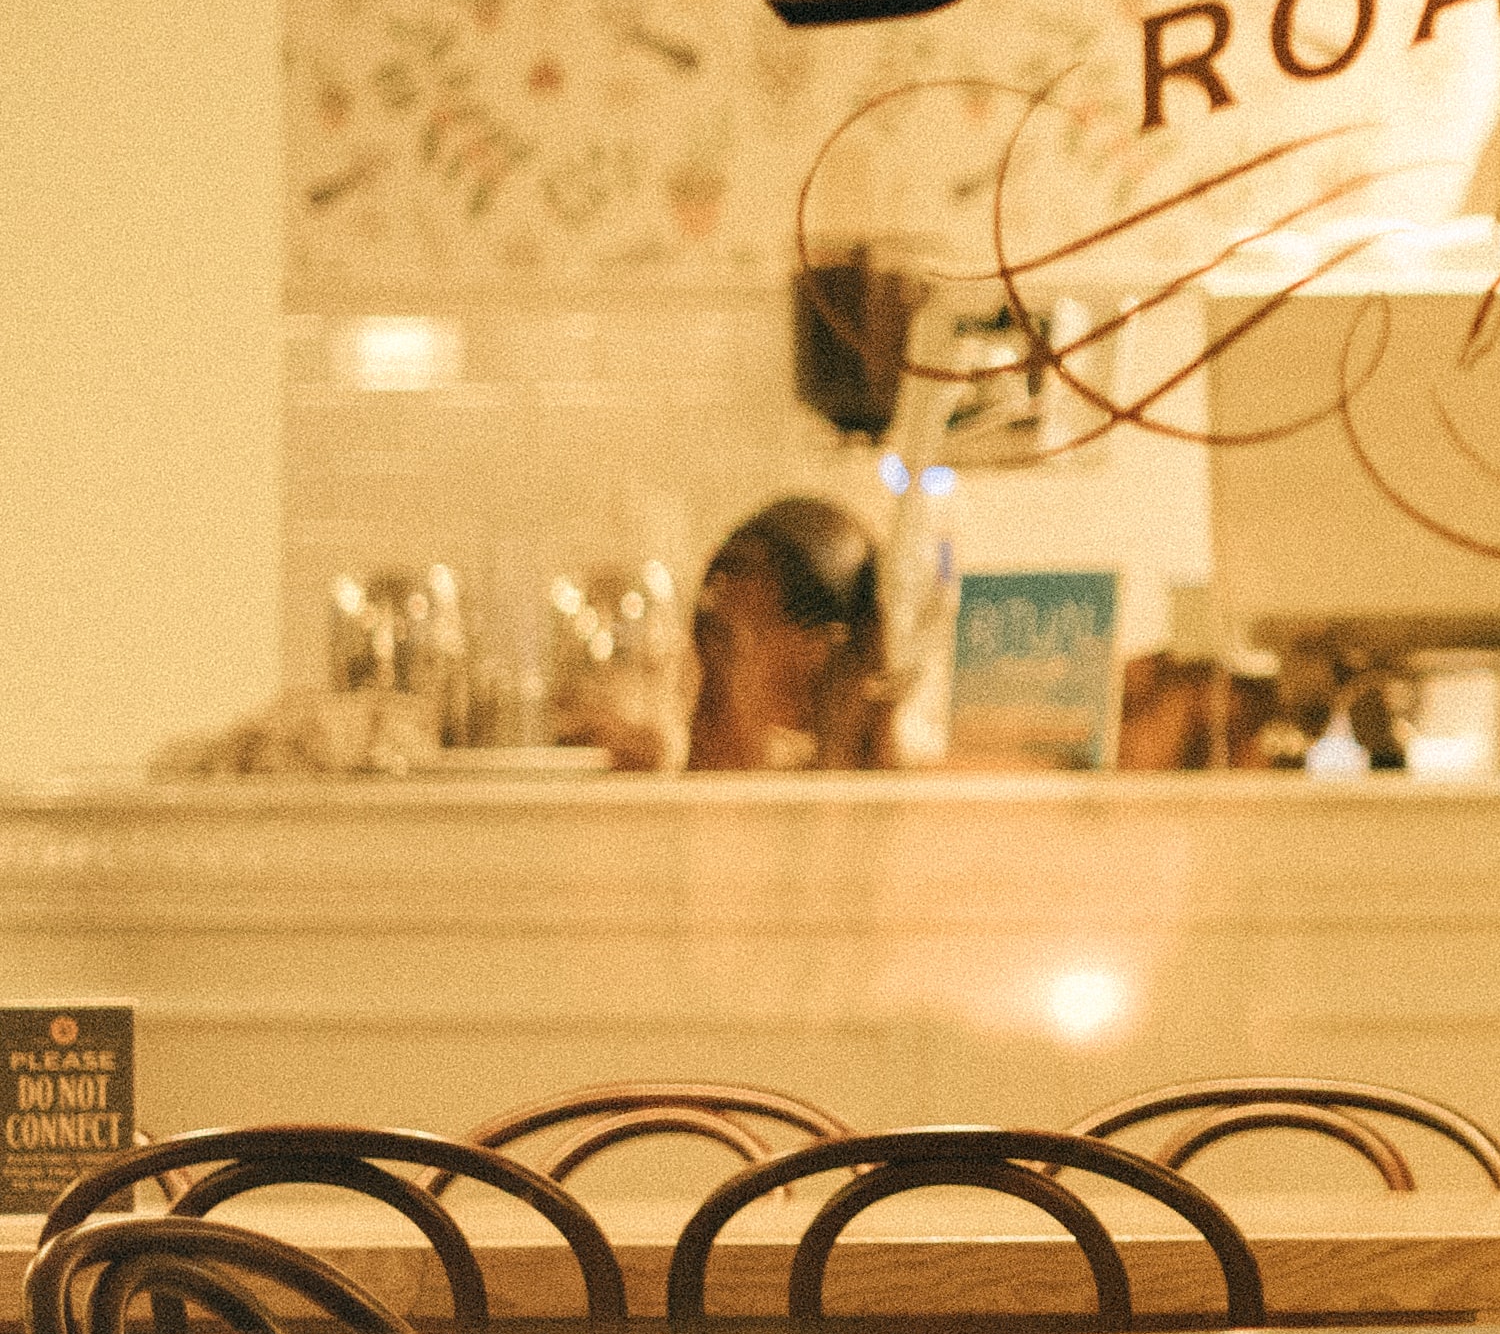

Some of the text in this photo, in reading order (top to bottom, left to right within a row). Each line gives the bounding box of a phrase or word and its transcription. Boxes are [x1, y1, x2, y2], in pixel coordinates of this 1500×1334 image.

[10, 1050, 116, 1071] PLEASE
[18, 1074, 110, 1110] DO NOT
[5, 1112, 122, 1149] CONNECT
